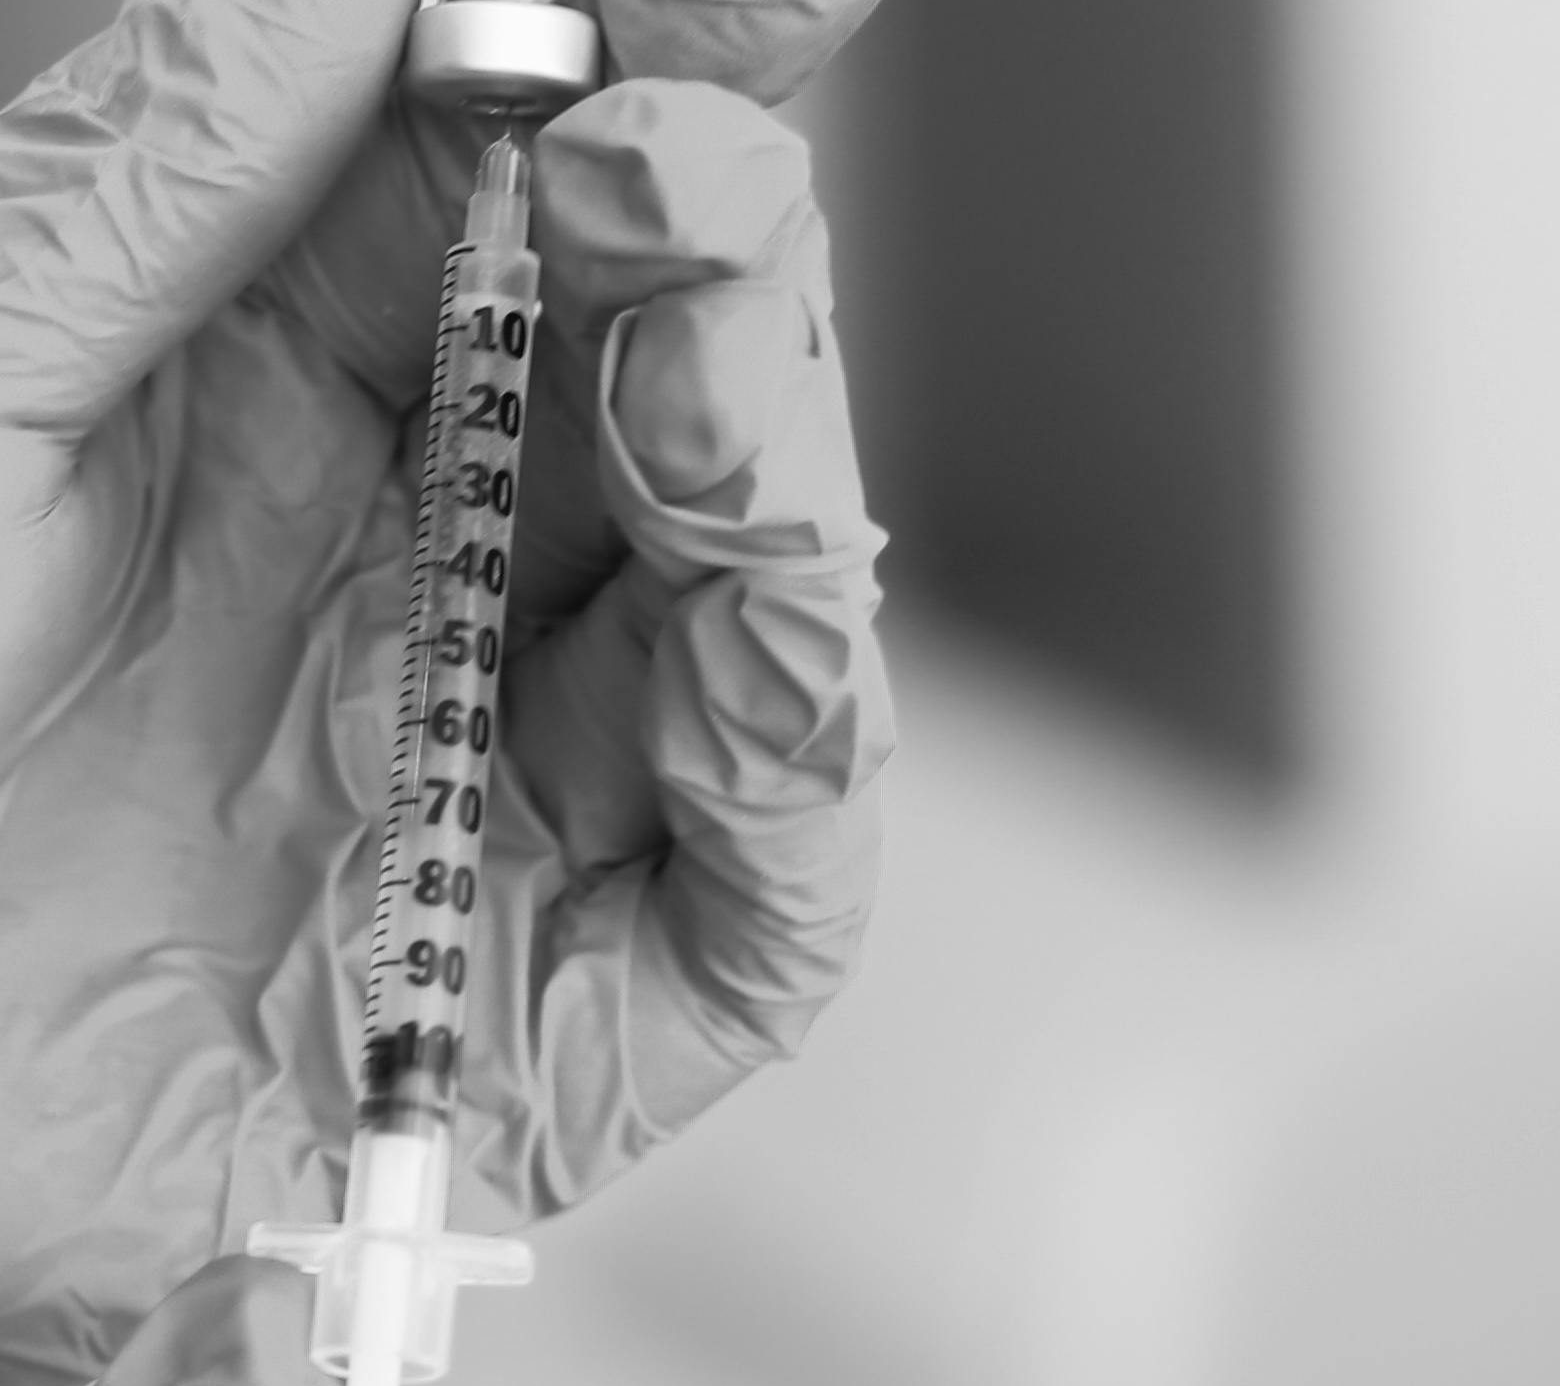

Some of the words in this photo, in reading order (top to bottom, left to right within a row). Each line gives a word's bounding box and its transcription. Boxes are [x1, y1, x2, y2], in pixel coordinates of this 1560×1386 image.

[468, 307, 526, 360] 10
[461, 385, 520, 438] 20
[455, 463, 513, 517] 30
[445, 543, 505, 596] 40
[437, 620, 497, 676] 50
[429, 700, 489, 755] 60
[421, 780, 480, 835] 70
[413, 859, 475, 915] 80
[406, 940, 466, 995] 90
